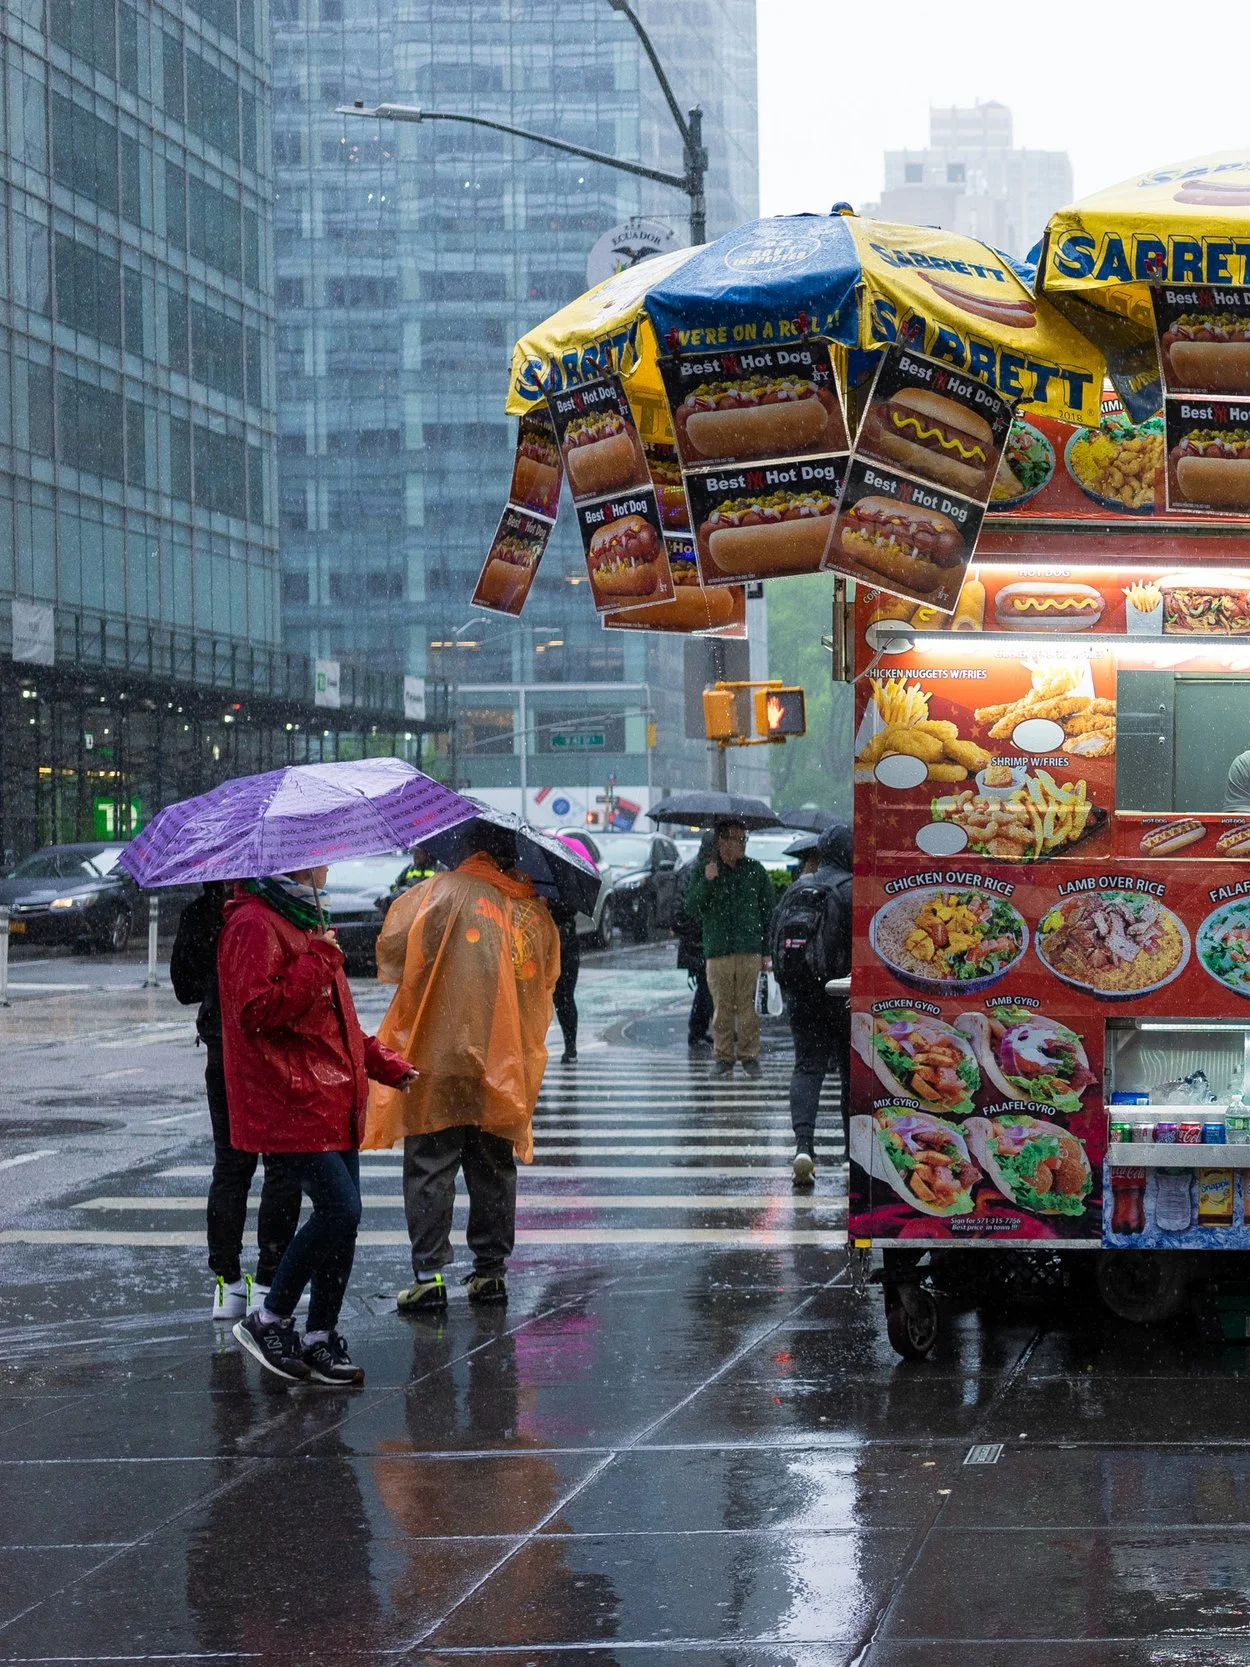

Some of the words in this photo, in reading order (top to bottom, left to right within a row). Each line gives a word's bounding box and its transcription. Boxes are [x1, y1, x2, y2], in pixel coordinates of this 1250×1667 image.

[612, 231, 662, 246] ECUADOR
[869, 242, 1005, 283] SABRETT
[1166, 290, 1199, 305] Best
[1214, 292, 1240, 305] Hot
[678, 325, 728, 347] WE'RE
[732, 323, 757, 342] ON
[762, 320, 774, 339] A
[870, 290, 1095, 411] SABRETT
[681, 357, 721, 375] Best
[741, 354, 774, 369] Hot
[777, 350, 812, 367] Dog
[899, 356, 932, 382] Best
[948, 378, 973, 398] Hot
[974, 391, 1001, 412] Dog
[556, 398, 576, 413] Best
[582, 390, 598, 405] Hot
[598, 386, 616, 399] Dog
[1058, 409, 1084, 423] 2018
[1180, 405, 1213, 420] Best
[706, 476, 746, 492] Best
[766, 469, 797, 485] Hot
[802, 464, 835, 482] Dog
[863, 469, 898, 494] Best
[912, 487, 939, 507] Hot
[940, 500, 967, 523] Dog
[585, 510, 605, 524] Best
[612, 504, 628, 518] Hot
[629, 500, 647, 513] Dog
[1018, 568, 1039, 577] HOT
[905, 669, 948, 679] NUGGETS
[950, 669, 988, 679] W/FRIES
[992, 757, 1028, 767] SHRIMP
[1030, 757, 1069, 767] W/FRIES
[884, 872, 943, 896] CHICKEN
[946, 870, 982, 887] OVER
[983, 878, 1014, 896] RICE
[1057, 877, 1096, 896] LAMB
[1098, 875, 1133, 890] OVER
[1136, 879, 1166, 897] RICE
[872, 999, 914, 1013] CHICKEN
[914, 1001, 941, 1015] GYRO
[985, 997, 1013, 1008] LAMB
[1014, 996, 1040, 1008] GYRO
[873, 1099, 889, 1109] MIX
[890, 1097, 919, 1109] GYRO
[982, 1100, 1026, 1116] FALAFEL
[1027, 1101, 1057, 1116] GYRO
[950, 1217, 965, 1225] Sign
[966, 1224, 984, 1232] price
